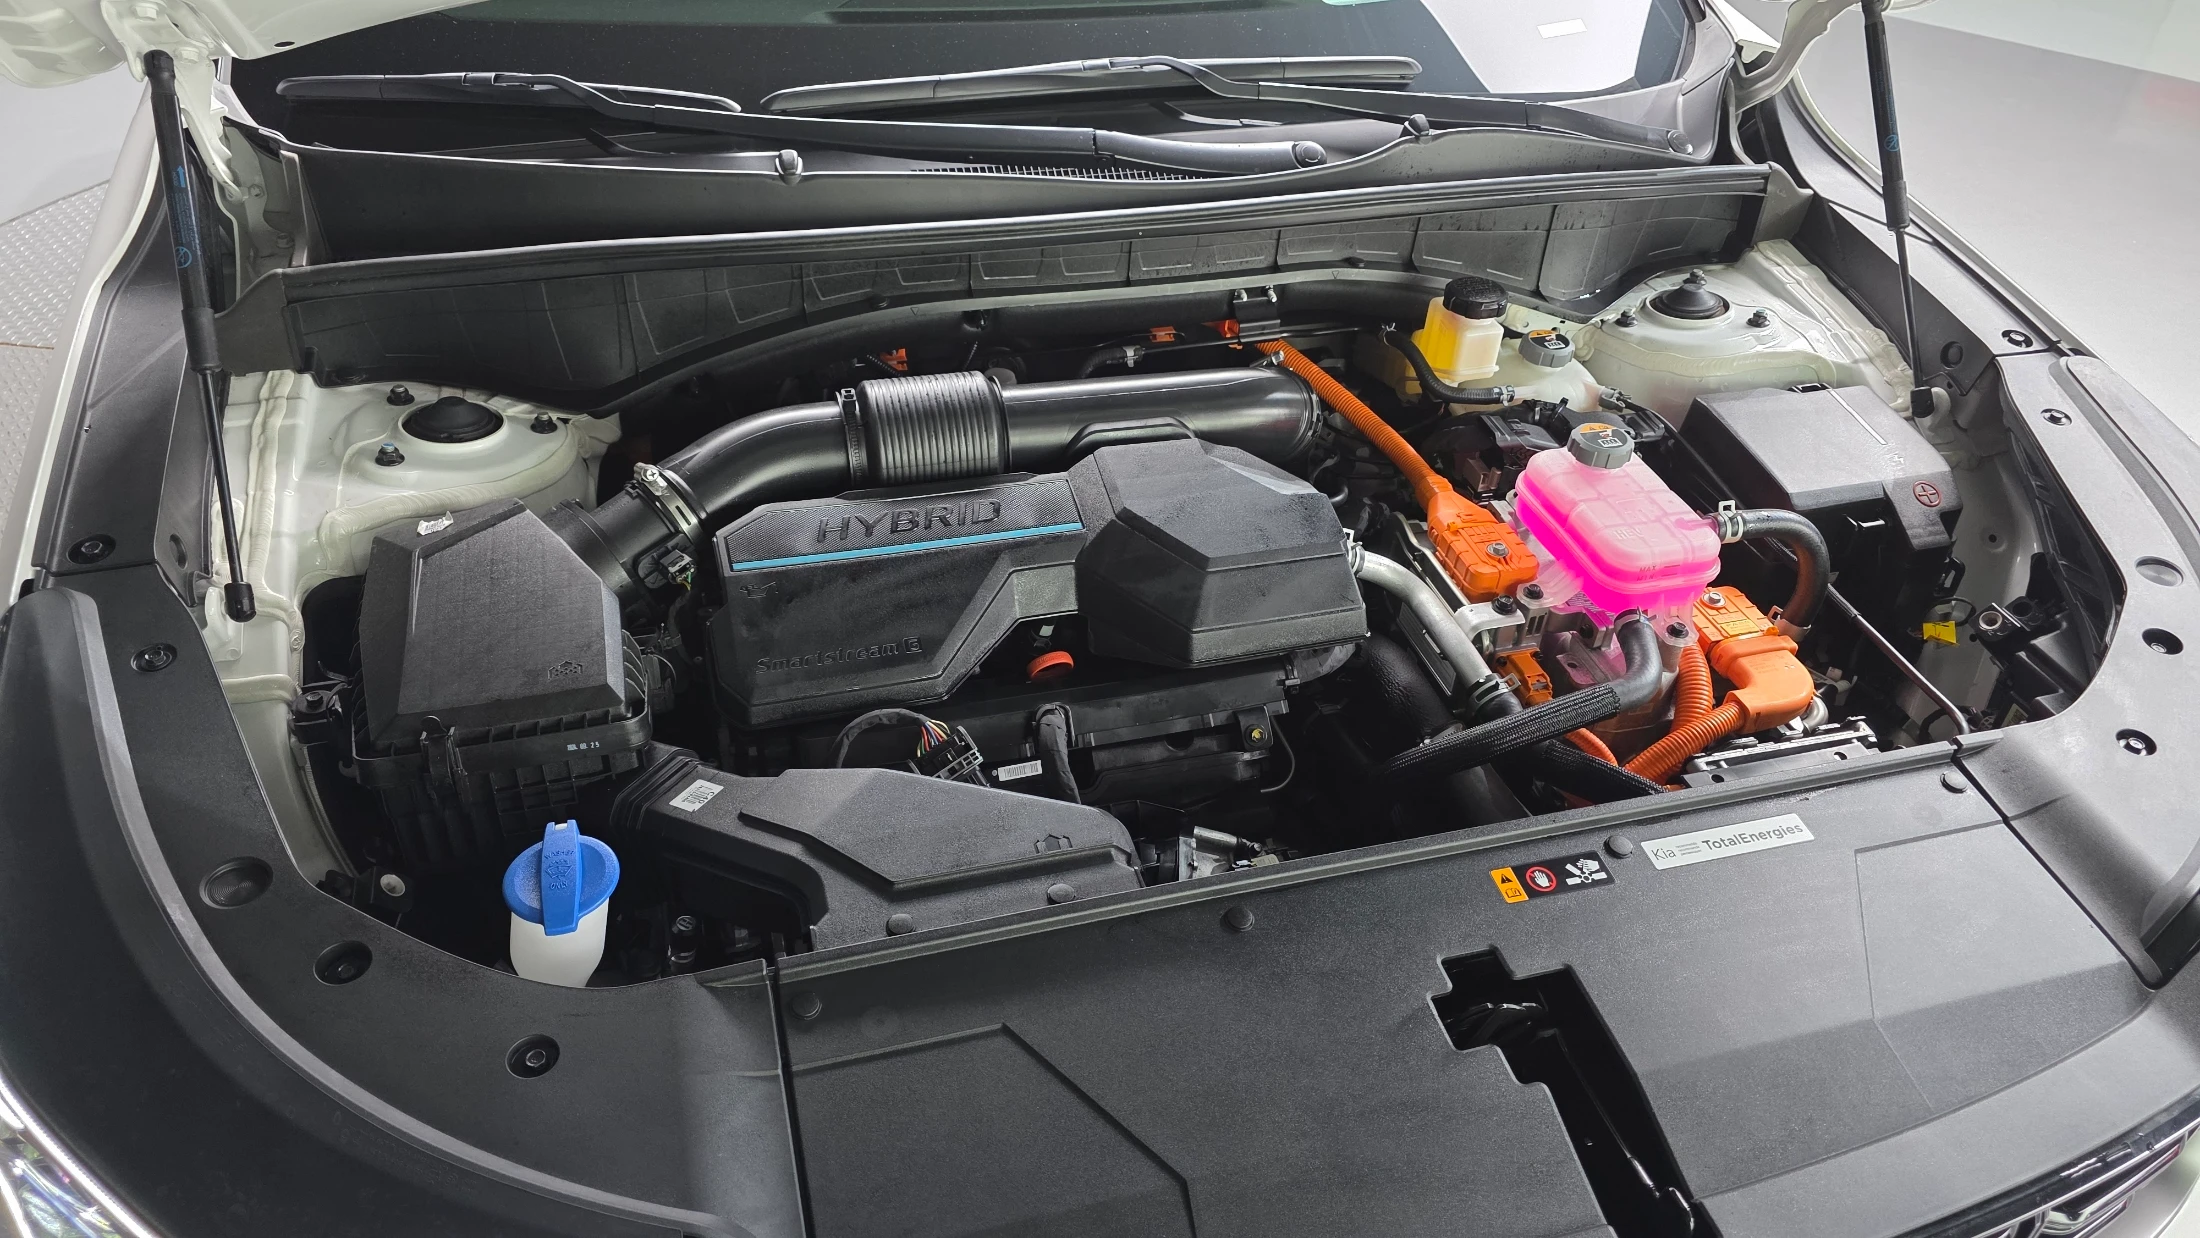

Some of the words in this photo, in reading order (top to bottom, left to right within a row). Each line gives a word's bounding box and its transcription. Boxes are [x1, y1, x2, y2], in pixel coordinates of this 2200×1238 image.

[816, 499, 1001, 543] HYBRID
[755, 643, 899, 674] Smartstream
[1651, 847, 1677, 861] Kia
[1701, 824, 1804, 851] TotalEnergies
